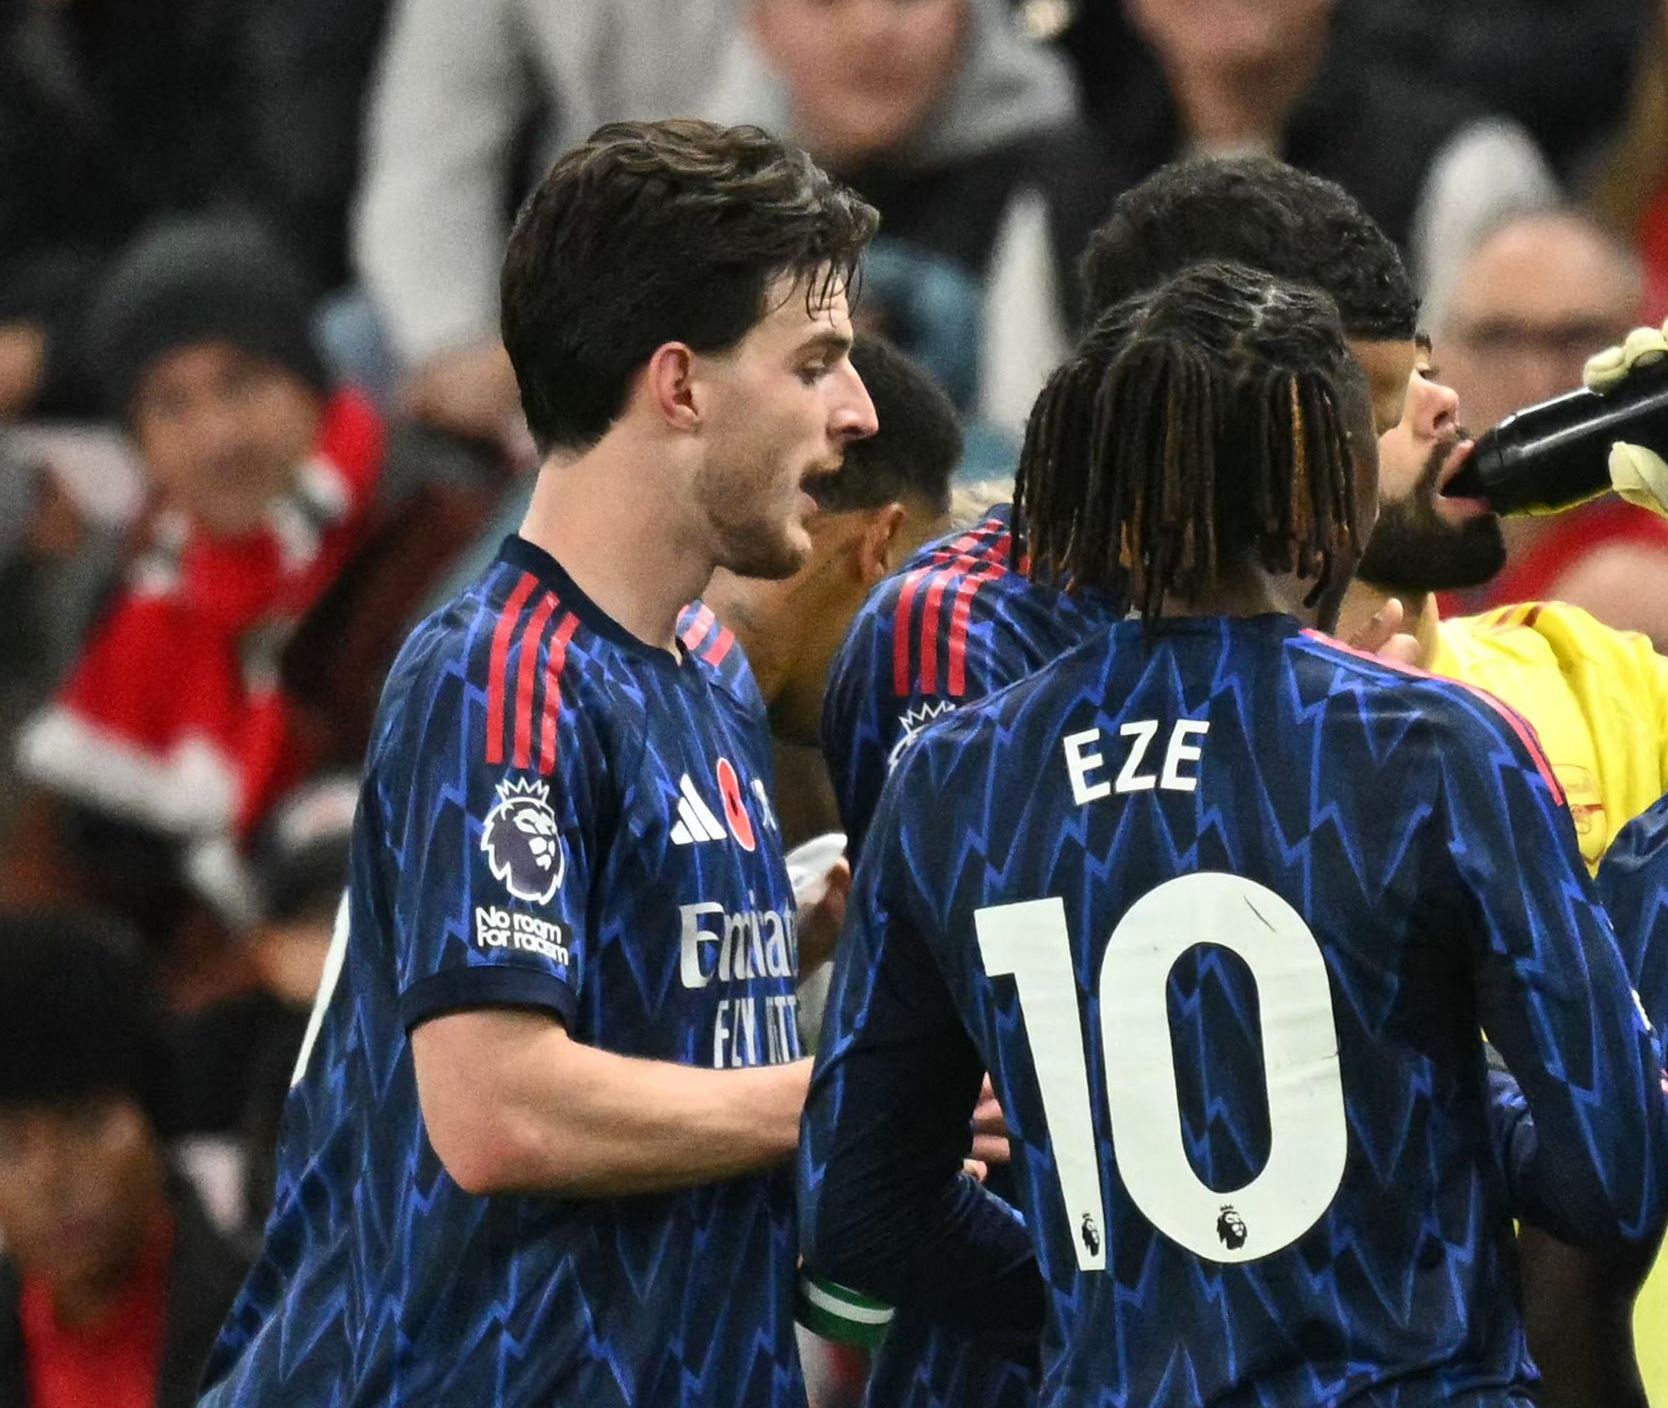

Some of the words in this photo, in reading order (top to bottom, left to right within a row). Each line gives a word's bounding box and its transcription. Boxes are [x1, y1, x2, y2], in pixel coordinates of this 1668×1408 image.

[1062, 719, 1209, 805] EZE
[475, 906, 510, 928] No
[513, 912, 561, 944] room
[477, 926, 511, 947] for
[713, 996, 756, 1069] FLY
[973, 872, 1348, 1271] 10
